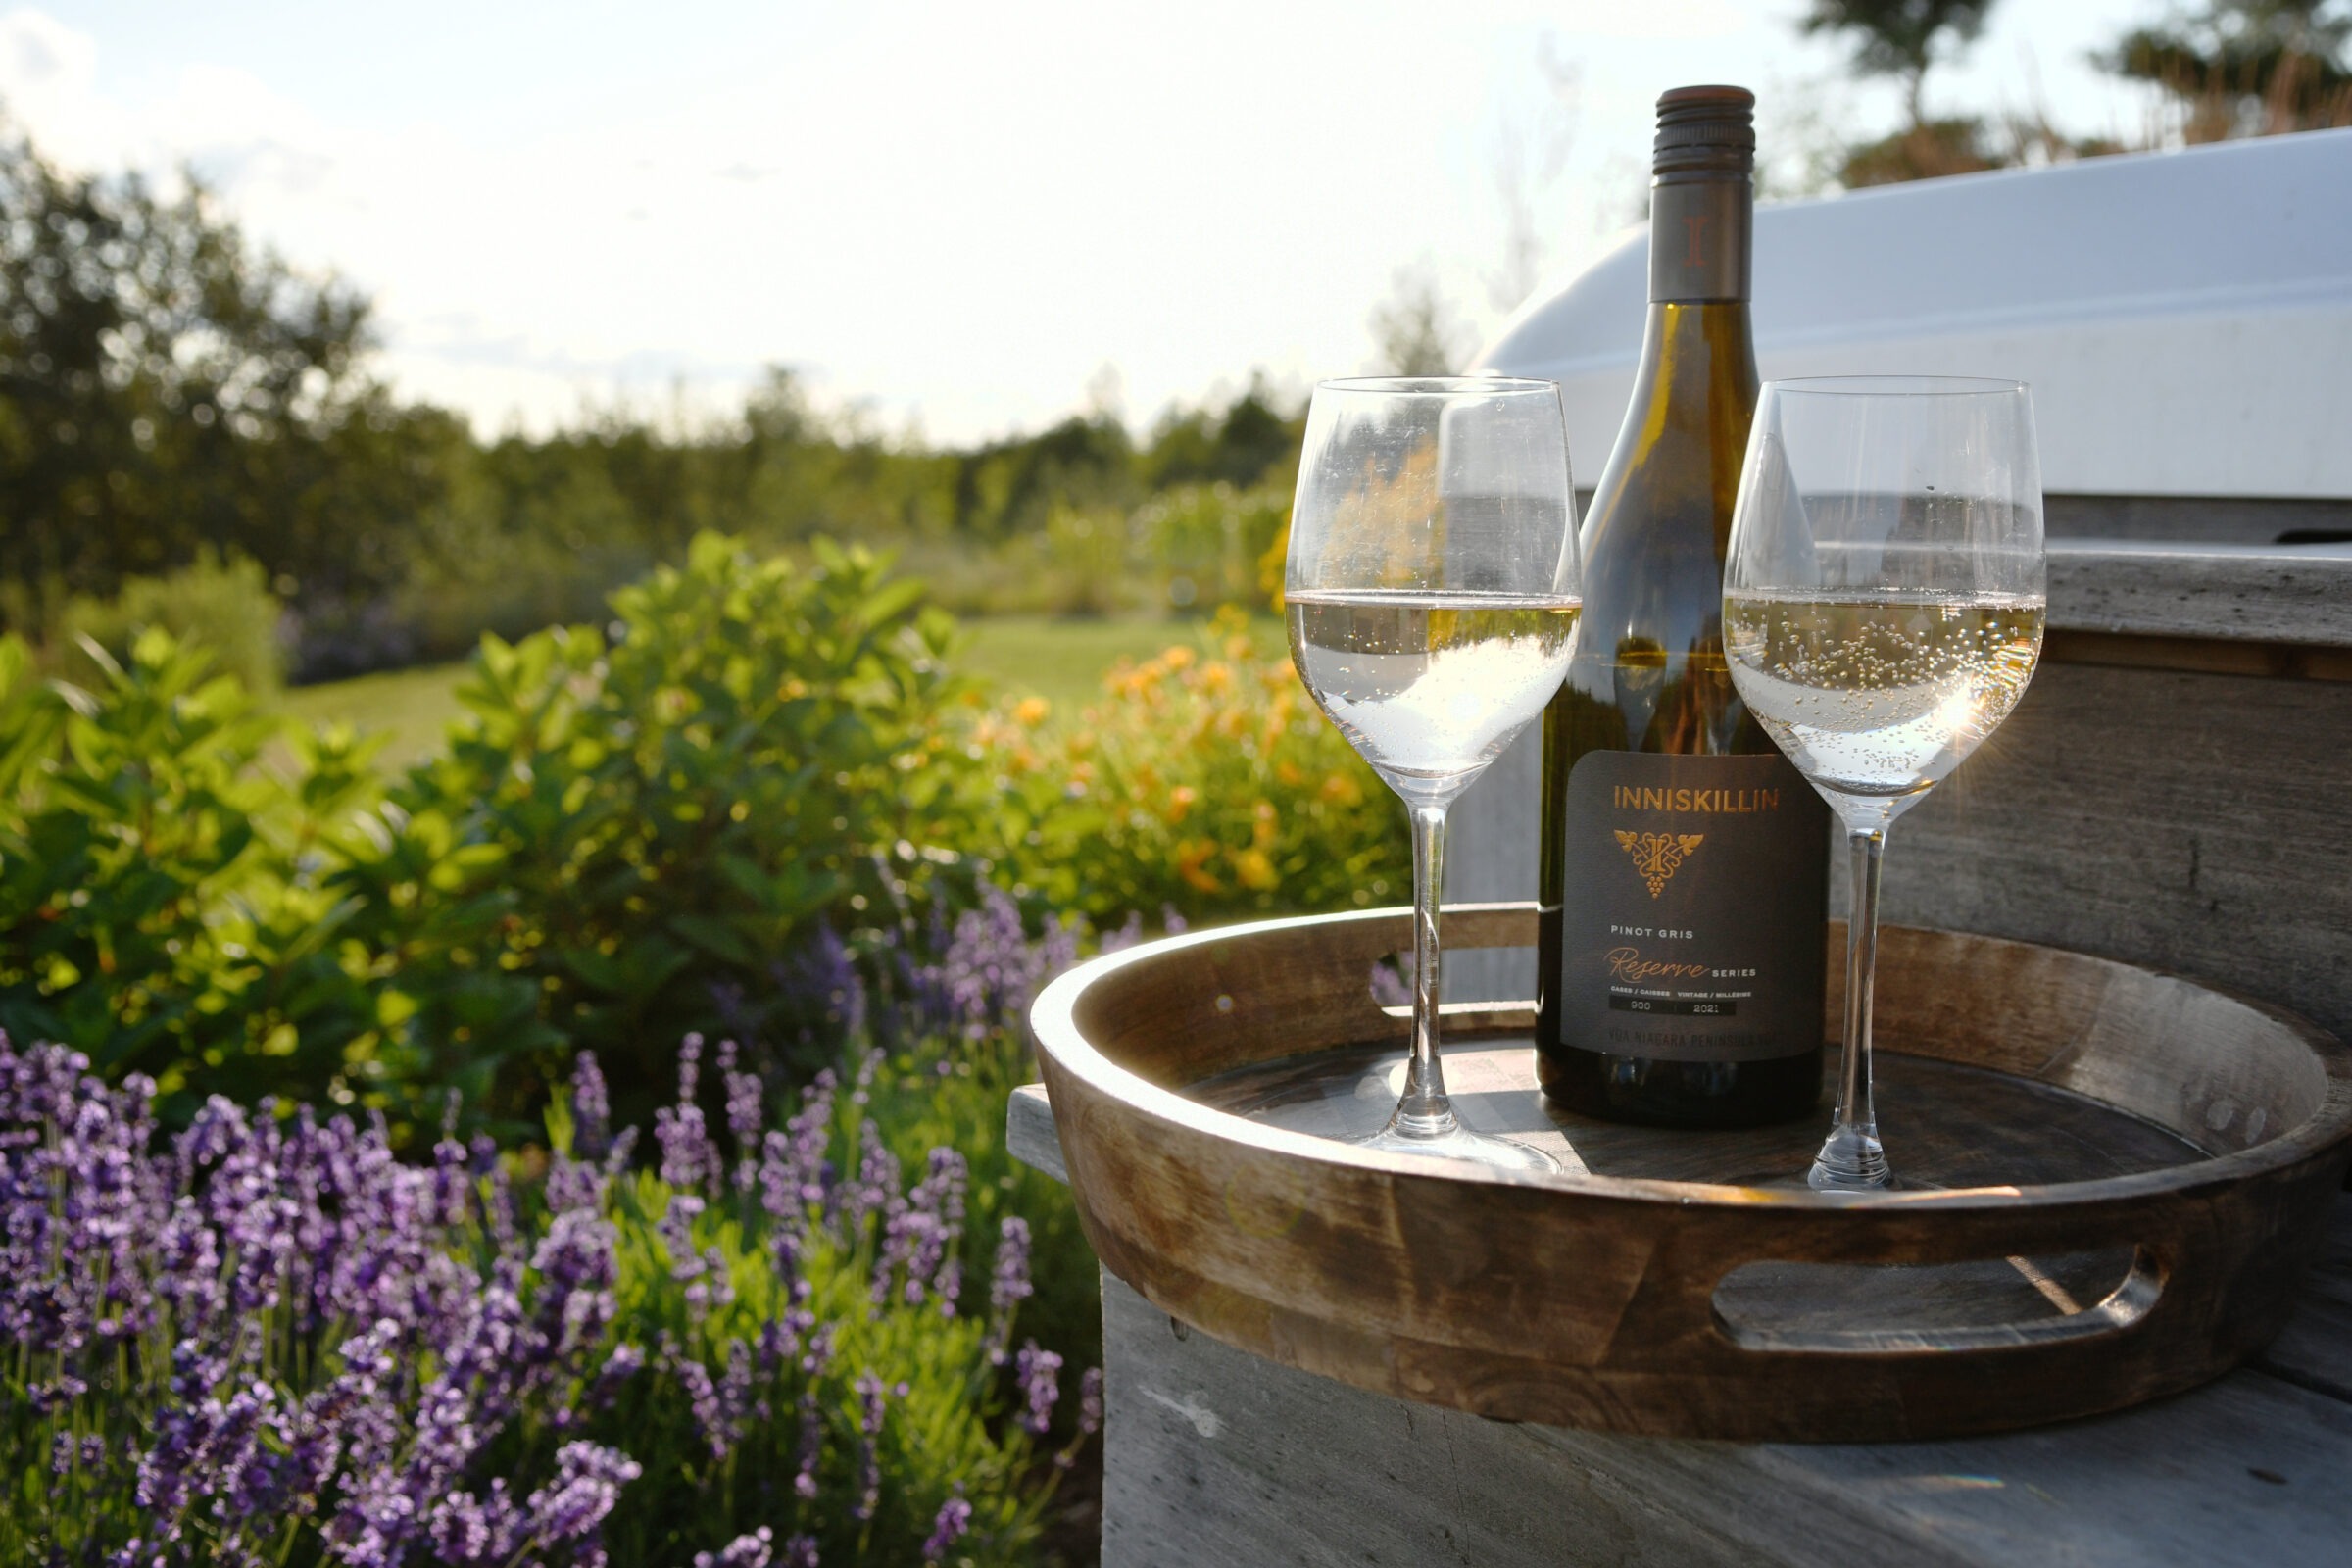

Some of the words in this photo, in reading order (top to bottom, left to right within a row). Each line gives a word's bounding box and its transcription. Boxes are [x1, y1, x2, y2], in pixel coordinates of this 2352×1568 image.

[1613, 786, 1780, 812] INNISKILLIN
[1610, 925, 1653, 937] PINOT
[1658, 929, 1693, 940] GRIS
[1603, 947, 1710, 984] Reserve
[1712, 968, 1756, 978] SERIES
[1631, 1001, 1651, 1010] 900
[1693, 1004, 1719, 1013] 2021
[1635, 1031, 1686, 1047] NIAGARA
